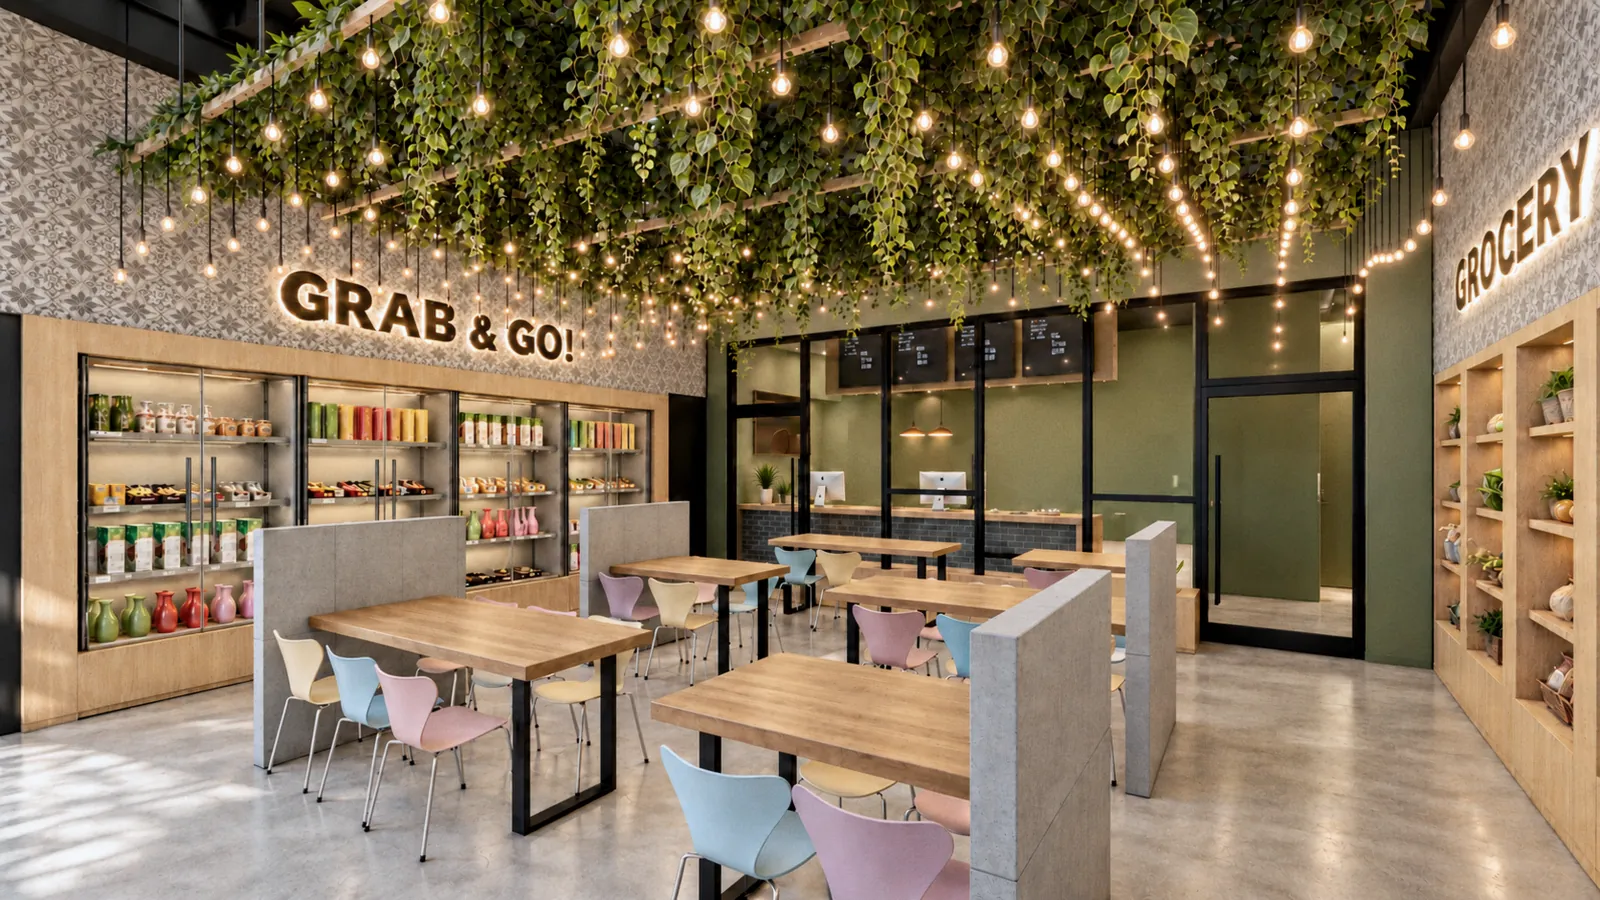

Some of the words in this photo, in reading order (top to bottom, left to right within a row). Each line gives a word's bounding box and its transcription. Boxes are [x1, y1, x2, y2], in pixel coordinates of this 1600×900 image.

[1455, 130, 1591, 311] GROCERY
[280, 270, 457, 342] GRAB
[469, 314, 498, 352] &
[508, 319, 574, 363] GO!
